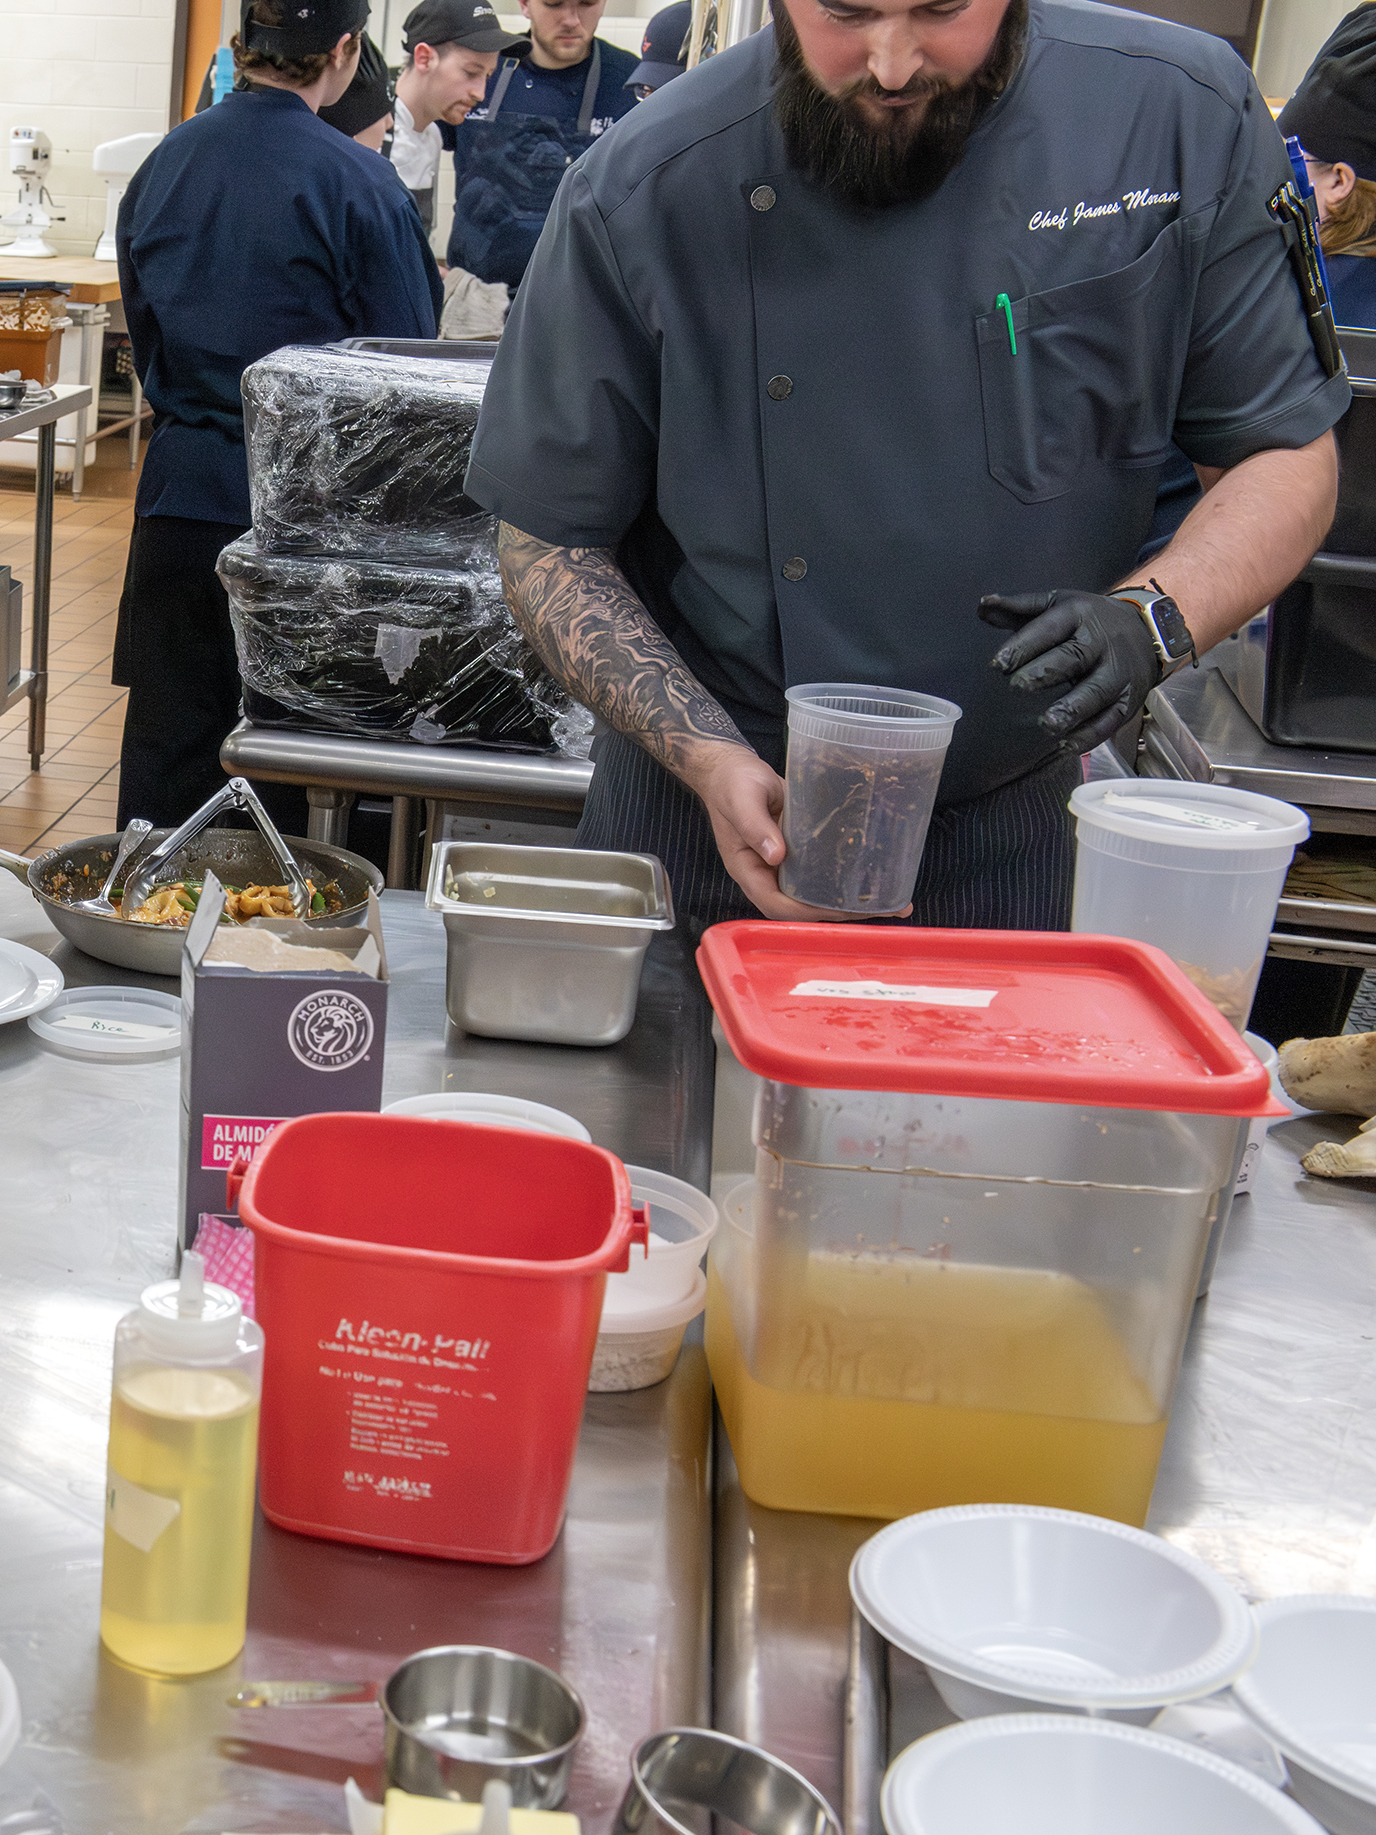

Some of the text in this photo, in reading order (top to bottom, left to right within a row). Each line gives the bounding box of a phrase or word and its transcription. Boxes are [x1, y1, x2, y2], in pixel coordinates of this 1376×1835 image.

[1028, 207, 1069, 231] Chef
[1072, 201, 1122, 226] James
[297, 995, 366, 1022] MONARCH
[213, 1144, 260, 1162] DE M
